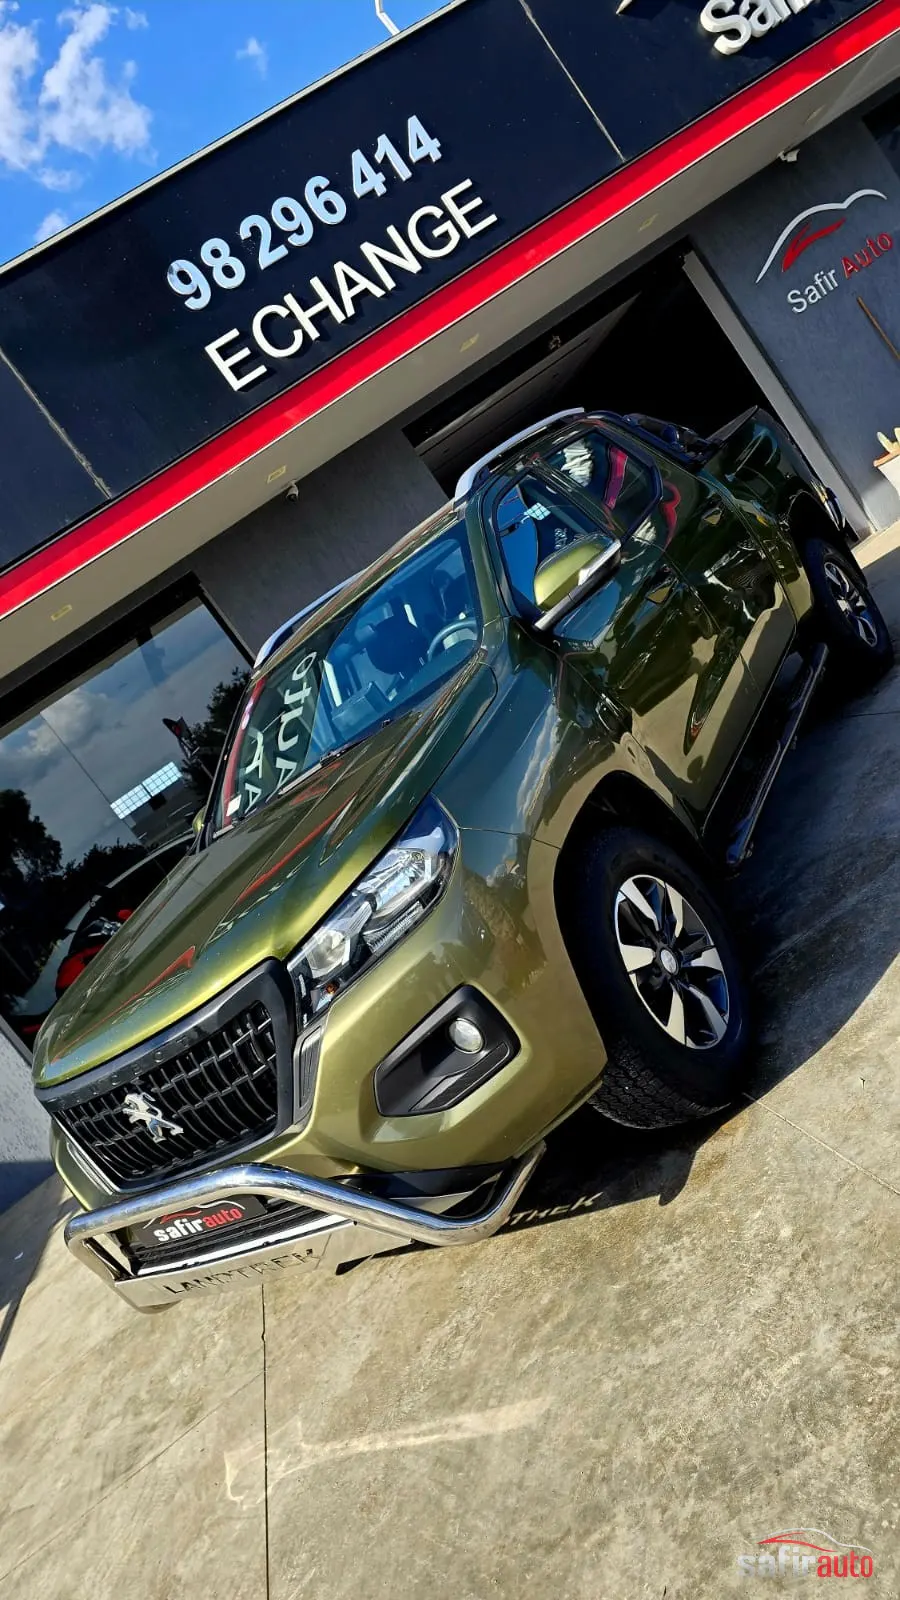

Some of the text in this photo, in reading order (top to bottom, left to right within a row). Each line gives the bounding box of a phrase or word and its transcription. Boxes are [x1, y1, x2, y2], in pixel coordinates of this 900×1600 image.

[167, 114, 442, 311] 98 296 414
[204, 178, 498, 392] ECHANGE
[787, 232, 893, 314] Safir Auto
